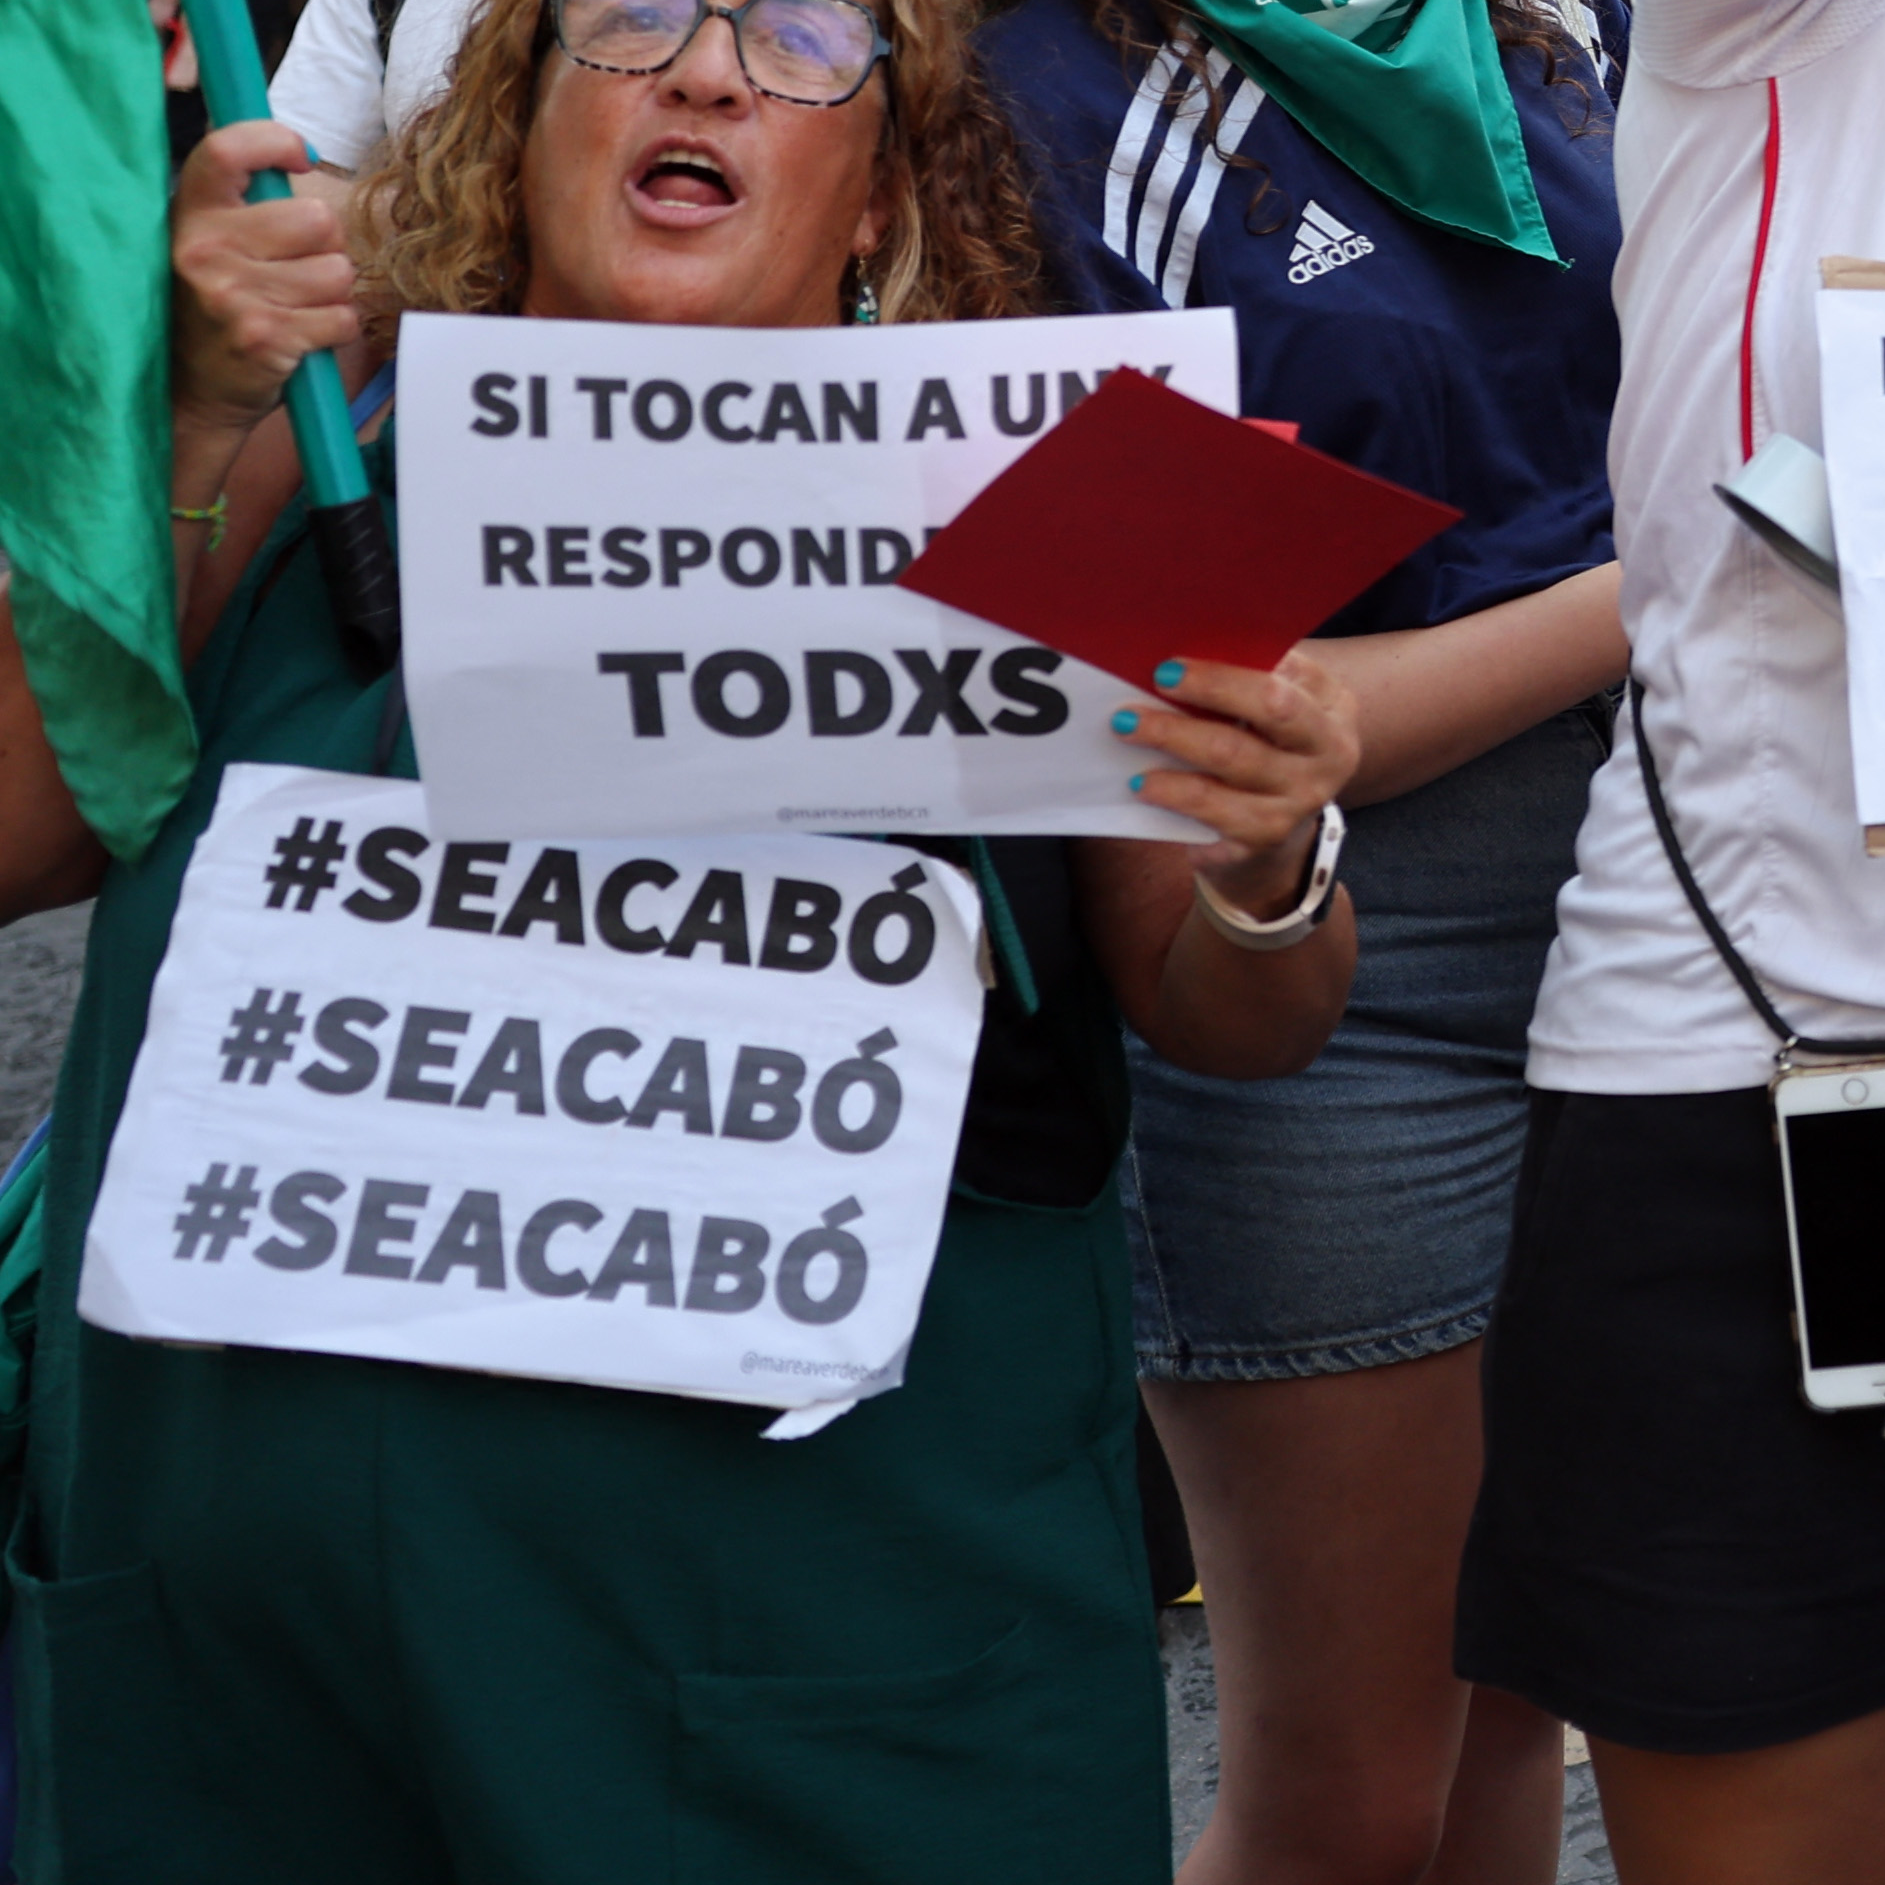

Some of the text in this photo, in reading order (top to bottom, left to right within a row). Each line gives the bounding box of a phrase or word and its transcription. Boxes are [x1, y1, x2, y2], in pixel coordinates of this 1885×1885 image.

[1288, 233, 1375, 285] adidas
[470, 373, 549, 439] SI
[577, 377, 879, 444] TOCAN
[906, 378, 965, 441] A
[482, 524, 943, 588] RESPOND
[598, 648, 1072, 737] TODXS
[264, 815, 936, 986] #SEACABÓ
[219, 987, 904, 1155] #SEACABÓ
[172, 1162, 870, 1327] #SEACABÓ
